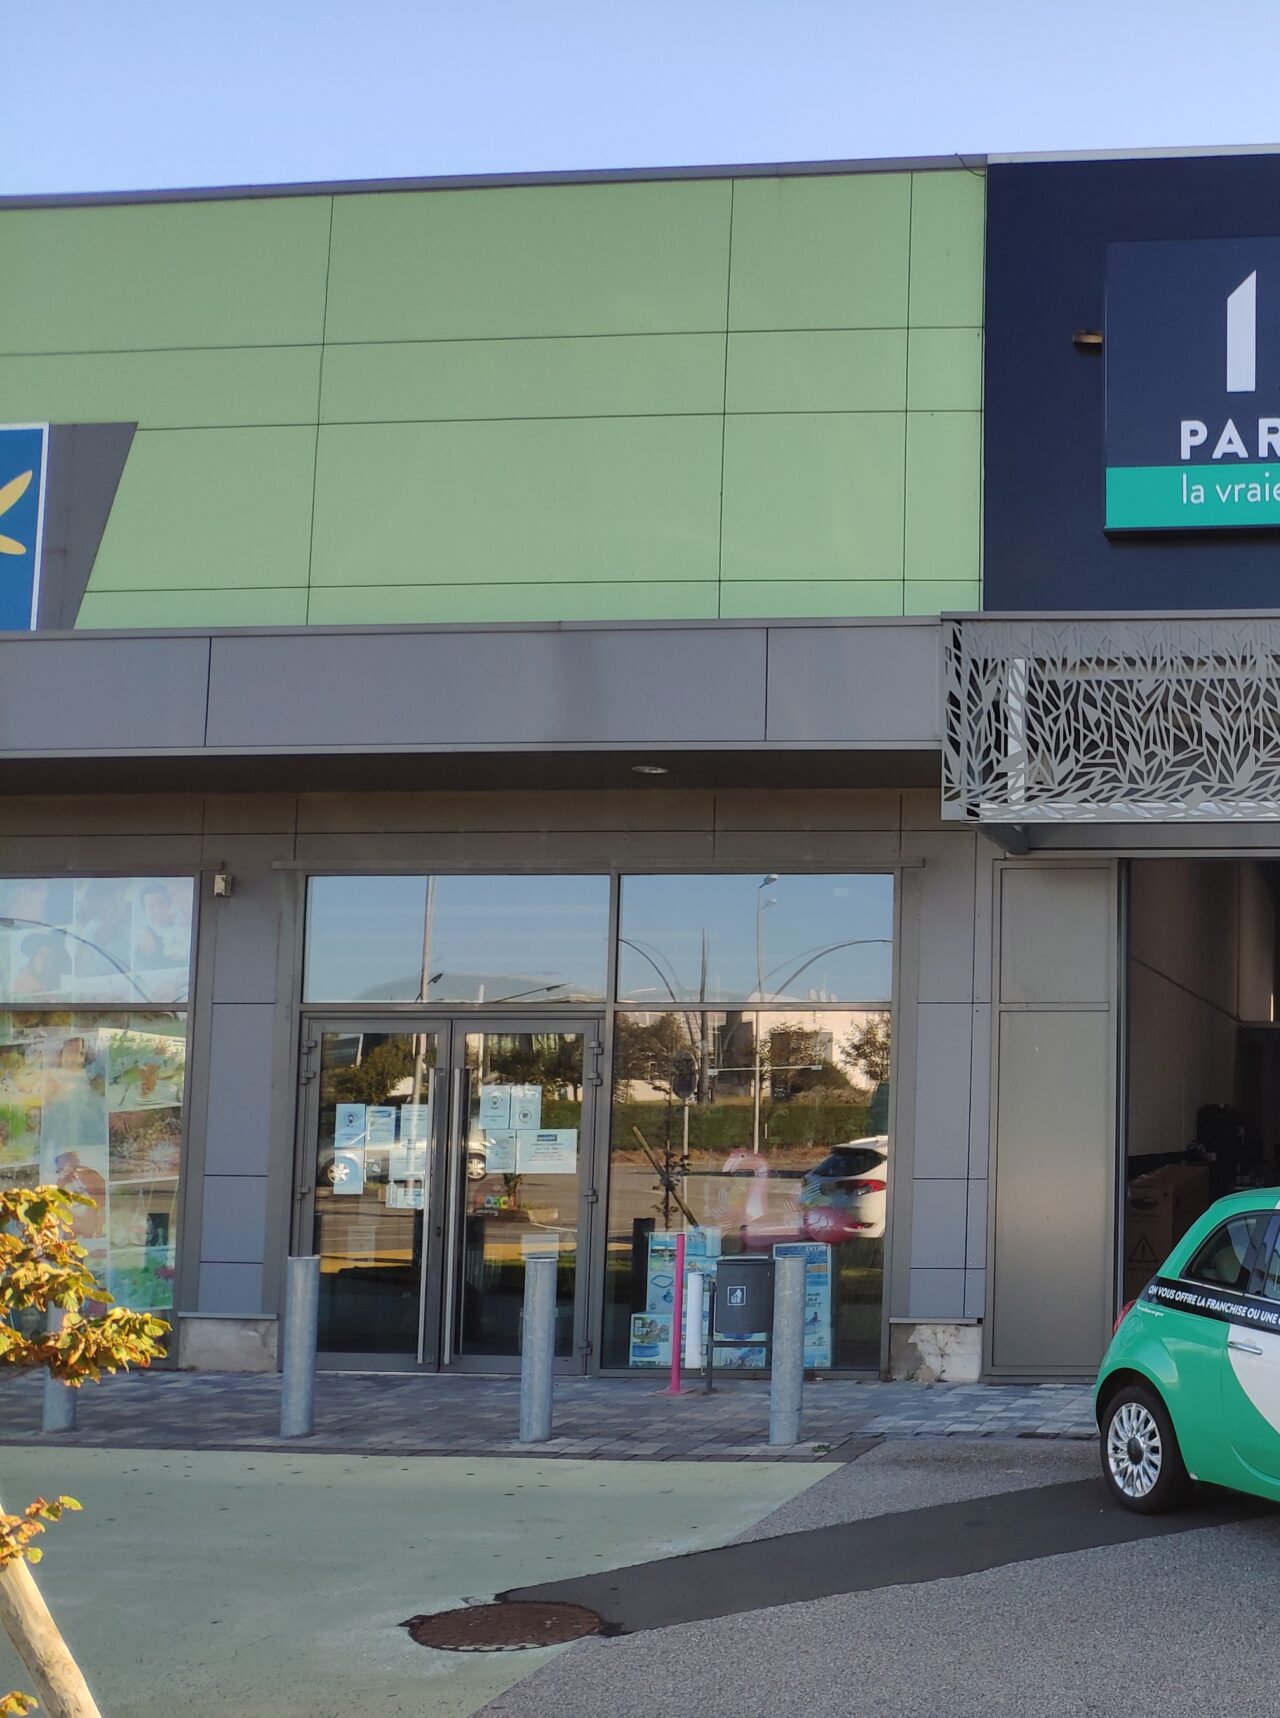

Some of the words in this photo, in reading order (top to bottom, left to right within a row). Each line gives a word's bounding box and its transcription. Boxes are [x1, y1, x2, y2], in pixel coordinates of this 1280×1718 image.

[1182, 473, 1205, 505] la
[1148, 1284, 1158, 1297] ON
[1157, 1287, 1175, 1300] VOUS
[1174, 1290, 1197, 1305] OFFRE
[1196, 1295, 1206, 1307] LA
[1205, 1298, 1247, 1317] FRANCHISE
[1247, 1308, 1260, 1320] OU
[1260, 1311, 1280, 1324] UNE
